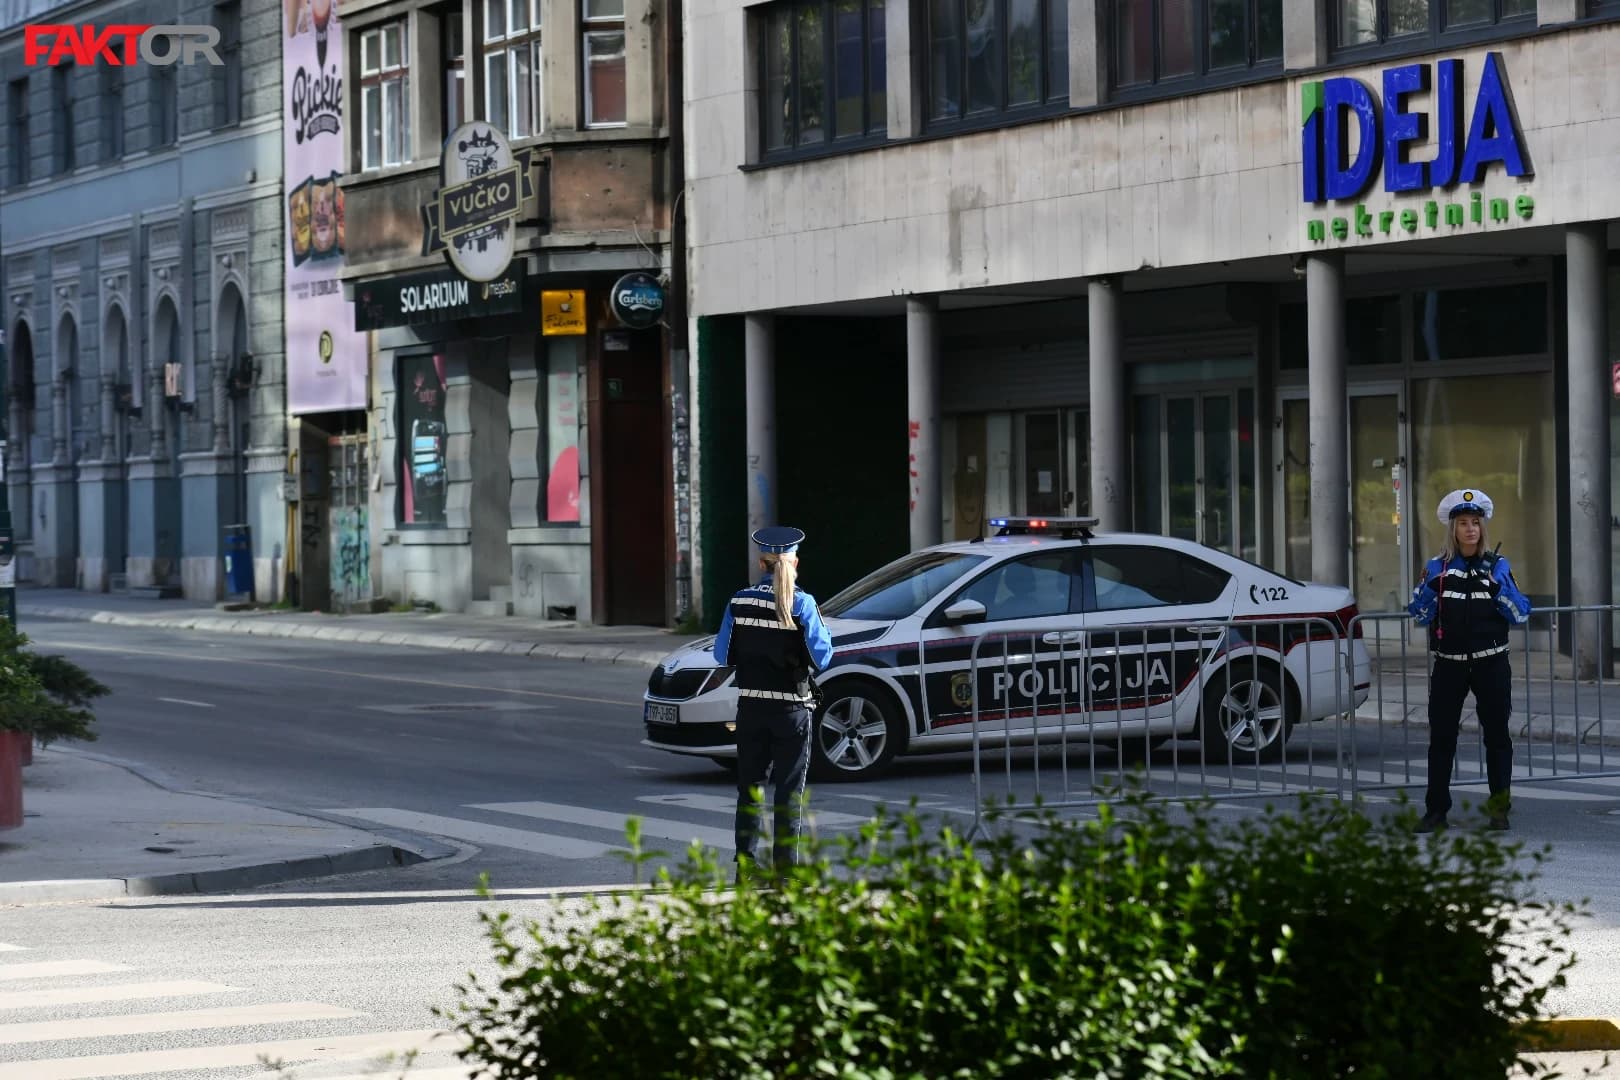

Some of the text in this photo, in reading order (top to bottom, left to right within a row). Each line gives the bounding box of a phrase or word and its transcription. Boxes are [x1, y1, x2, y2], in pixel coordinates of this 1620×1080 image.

[1301, 51, 1534, 203] IDEJA
[449, 182, 511, 217] VUČKO
[1307, 191, 1535, 241] nekretnine
[400, 281, 469, 313] SOLARIJUM
[618, 289, 662, 308] Carlsberg
[1261, 586, 1289, 602] 122
